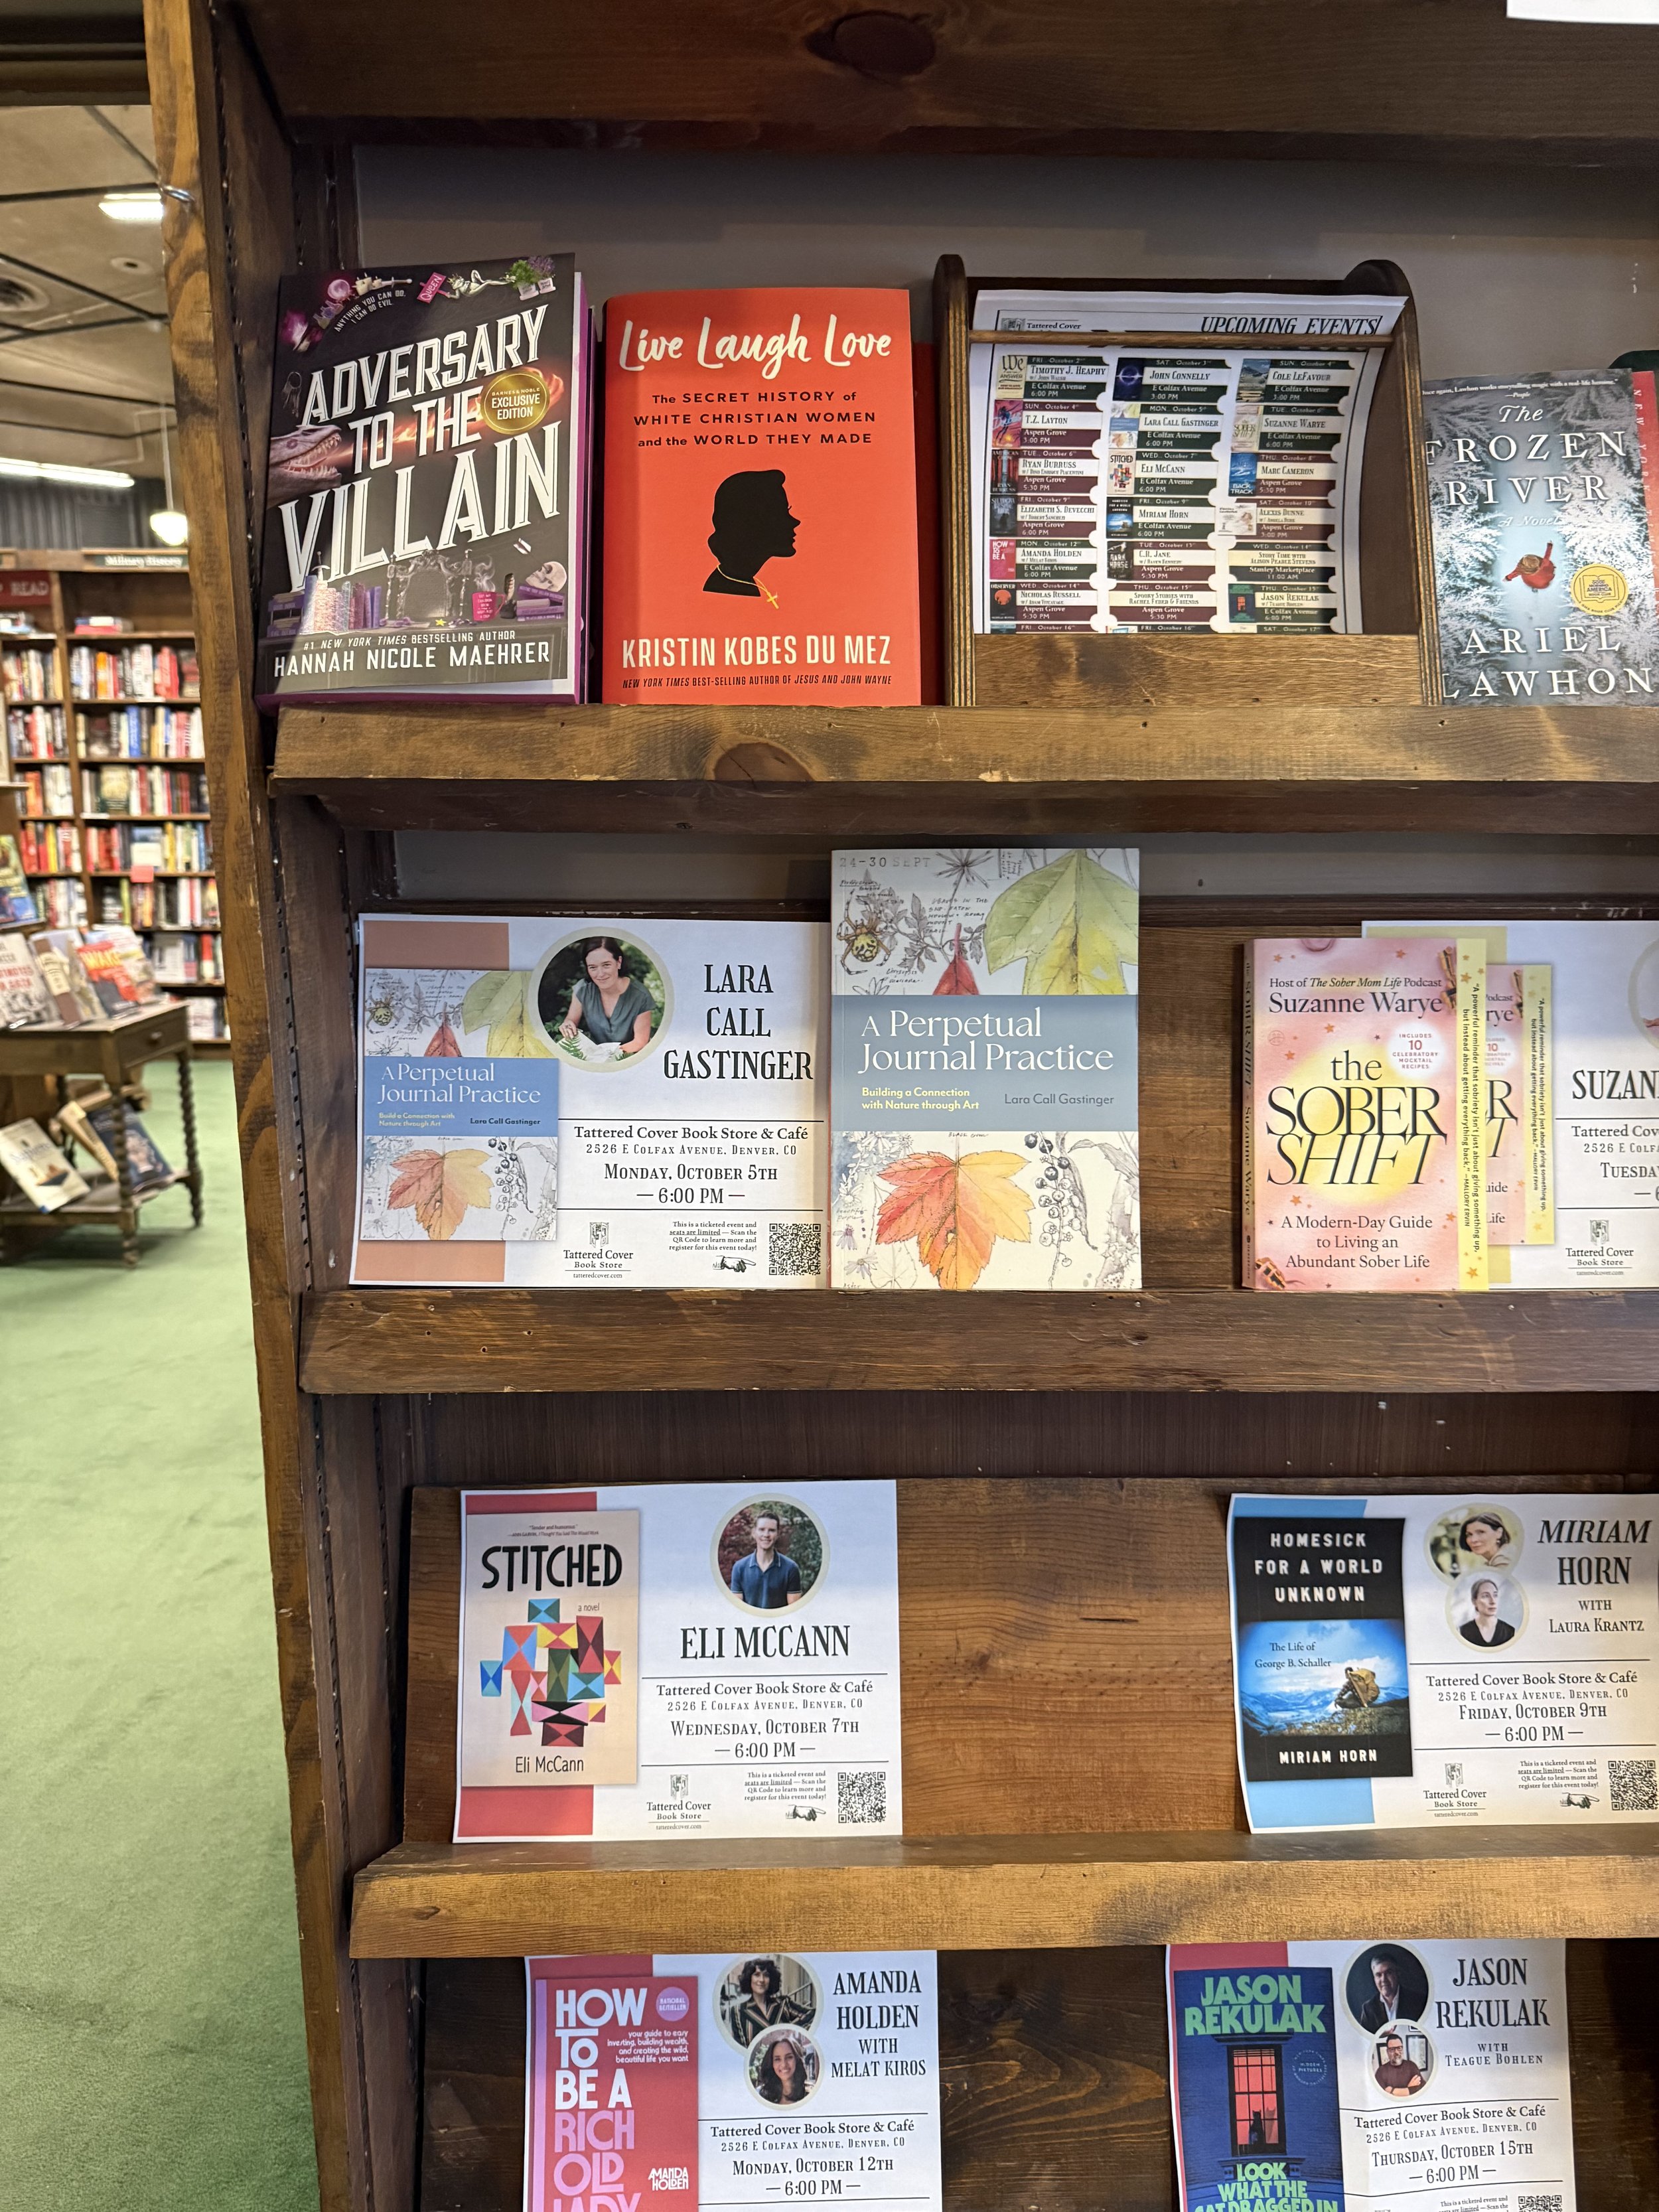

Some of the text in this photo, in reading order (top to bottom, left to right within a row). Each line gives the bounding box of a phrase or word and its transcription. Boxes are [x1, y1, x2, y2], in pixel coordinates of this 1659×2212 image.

[334, 305, 361, 331] ANYTHING
[362, 296, 375, 306] YOU
[1201, 317, 1297, 334] UPCOMING
[619, 313, 892, 380] Live Laugh Love
[302, 304, 549, 426] ADVERSARY
[492, 394, 540, 420] EXCLUSIVE EDITION
[652, 391, 857, 404] The SECRET HISTORY of
[634, 411, 876, 426] WHITE CHRISTIAN WOMEN
[1498, 405, 1544, 423] The
[348, 386, 483, 474] TO THE
[638, 433, 872, 447] and the WORLD THEY MADE
[1425, 431, 1627, 465] FROZEN
[1443, 475, 1609, 506] RIVER
[278, 420, 561, 593] VILLAIN
[1498, 516, 1560, 526] A Novel
[321, 638, 341, 649] NEW
[348, 637, 372, 647] YORK
[378, 635, 407, 646] TIMES
[411, 632, 473, 644] BESTSELLING
[480, 630, 516, 641] AUTHOR
[622, 634, 891, 668] KRISTIN KOBES DU MEZ
[1461, 625, 1621, 654] ARIEL
[274, 642, 550, 678] HANNAH NICOLE MAEHRER
[1442, 668, 1655, 700] LAWHON
[703, 964, 774, 994] LARA
[1269, 977, 1442, 989] Host of The Sober Mom Life Podcast
[1269, 992, 1443, 1019] Suzanne Warye
[706, 1007, 771, 1037] CALL
[861, 1007, 1041, 1046] A Perpetual
[664, 1049, 814, 1080] GASTINGER
[858, 1040, 1114, 1074] Journal Practice
[1331, 1050, 1382, 1081] the
[861, 1087, 903, 1098] Building
[913, 1087, 970, 1096] Connection
[861, 1100, 979, 1112] with Nature through Art
[1004, 1093, 1115, 1107] Lara Call Gastinger
[1266, 1086, 1447, 1145] SOBER
[574, 1126, 808, 1140] Tattered Cover Book Store & Café
[1267, 1133, 1433, 1185] SHIFT
[658, 1187, 723, 1204] 6:00 PM
[1281, 1215, 1433, 1232] A Modern-Day Guide
[1317, 1235, 1398, 1252] to Living an
[1285, 1255, 1430, 1268] Abundant Sober Life
[1271, 1532, 1366, 1548] HOMESICK
[1538, 1519, 1651, 1544] MIRIAM
[482, 1544, 622, 1591] STITCHED
[1254, 1560, 1384, 1575] FOR A WORLD
[1557, 1556, 1631, 1586] HORN
[1275, 1587, 1365, 1603] UNKNOWN
[1578, 1599, 1612, 1611] WITH
[680, 1625, 851, 1659] ELI MCCANN
[833, 1969, 922, 1995] AMANDA
[1452, 1958, 1528, 1988] JASON
[1200, 1975, 1302, 2007] JASON
[556, 1987, 647, 2028] HOW
[836, 2004, 919, 2031] HOLDEN
[1185, 2004, 1326, 2036] REKULAK
[1435, 1999, 1551, 2030] REKULAK
[556, 2028, 599, 2069] TO
[1478, 2043, 1508, 2053] WITH
[555, 2069, 632, 2110] BE A
[554, 2110, 634, 2153] RICH
[553, 2153, 624, 2197] OLD
